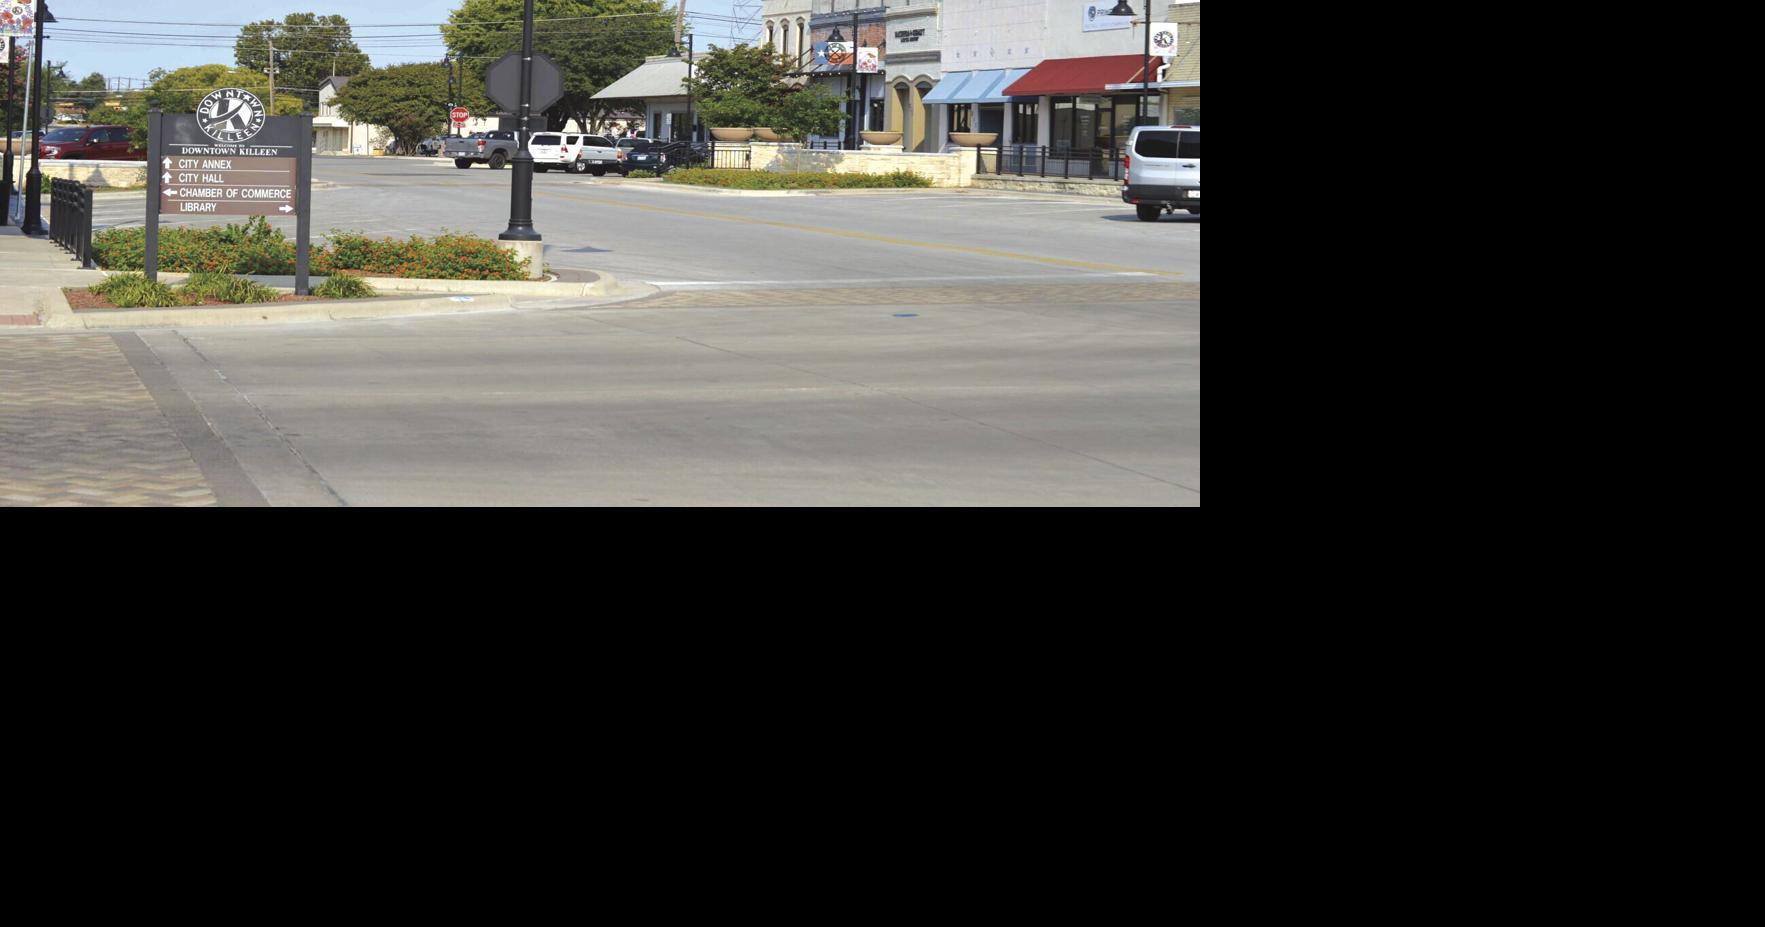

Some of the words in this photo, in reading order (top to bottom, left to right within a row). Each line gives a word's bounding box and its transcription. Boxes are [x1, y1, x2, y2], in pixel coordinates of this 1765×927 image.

[204, 123, 260, 141] KILLEEN
[182, 147, 236, 155] DOWNTOWN
[239, 148, 278, 156] KILLEEN
[178, 159, 199, 169] CITY
[202, 160, 232, 169] ANNEX
[178, 173, 199, 183] CITY
[202, 174, 224, 183] HALL
[179, 188, 223, 198] CHAMBER
[226, 189, 239, 198] OF
[241, 189, 292, 199] COMMERCE
[180, 203, 217, 212] LIBRARY
